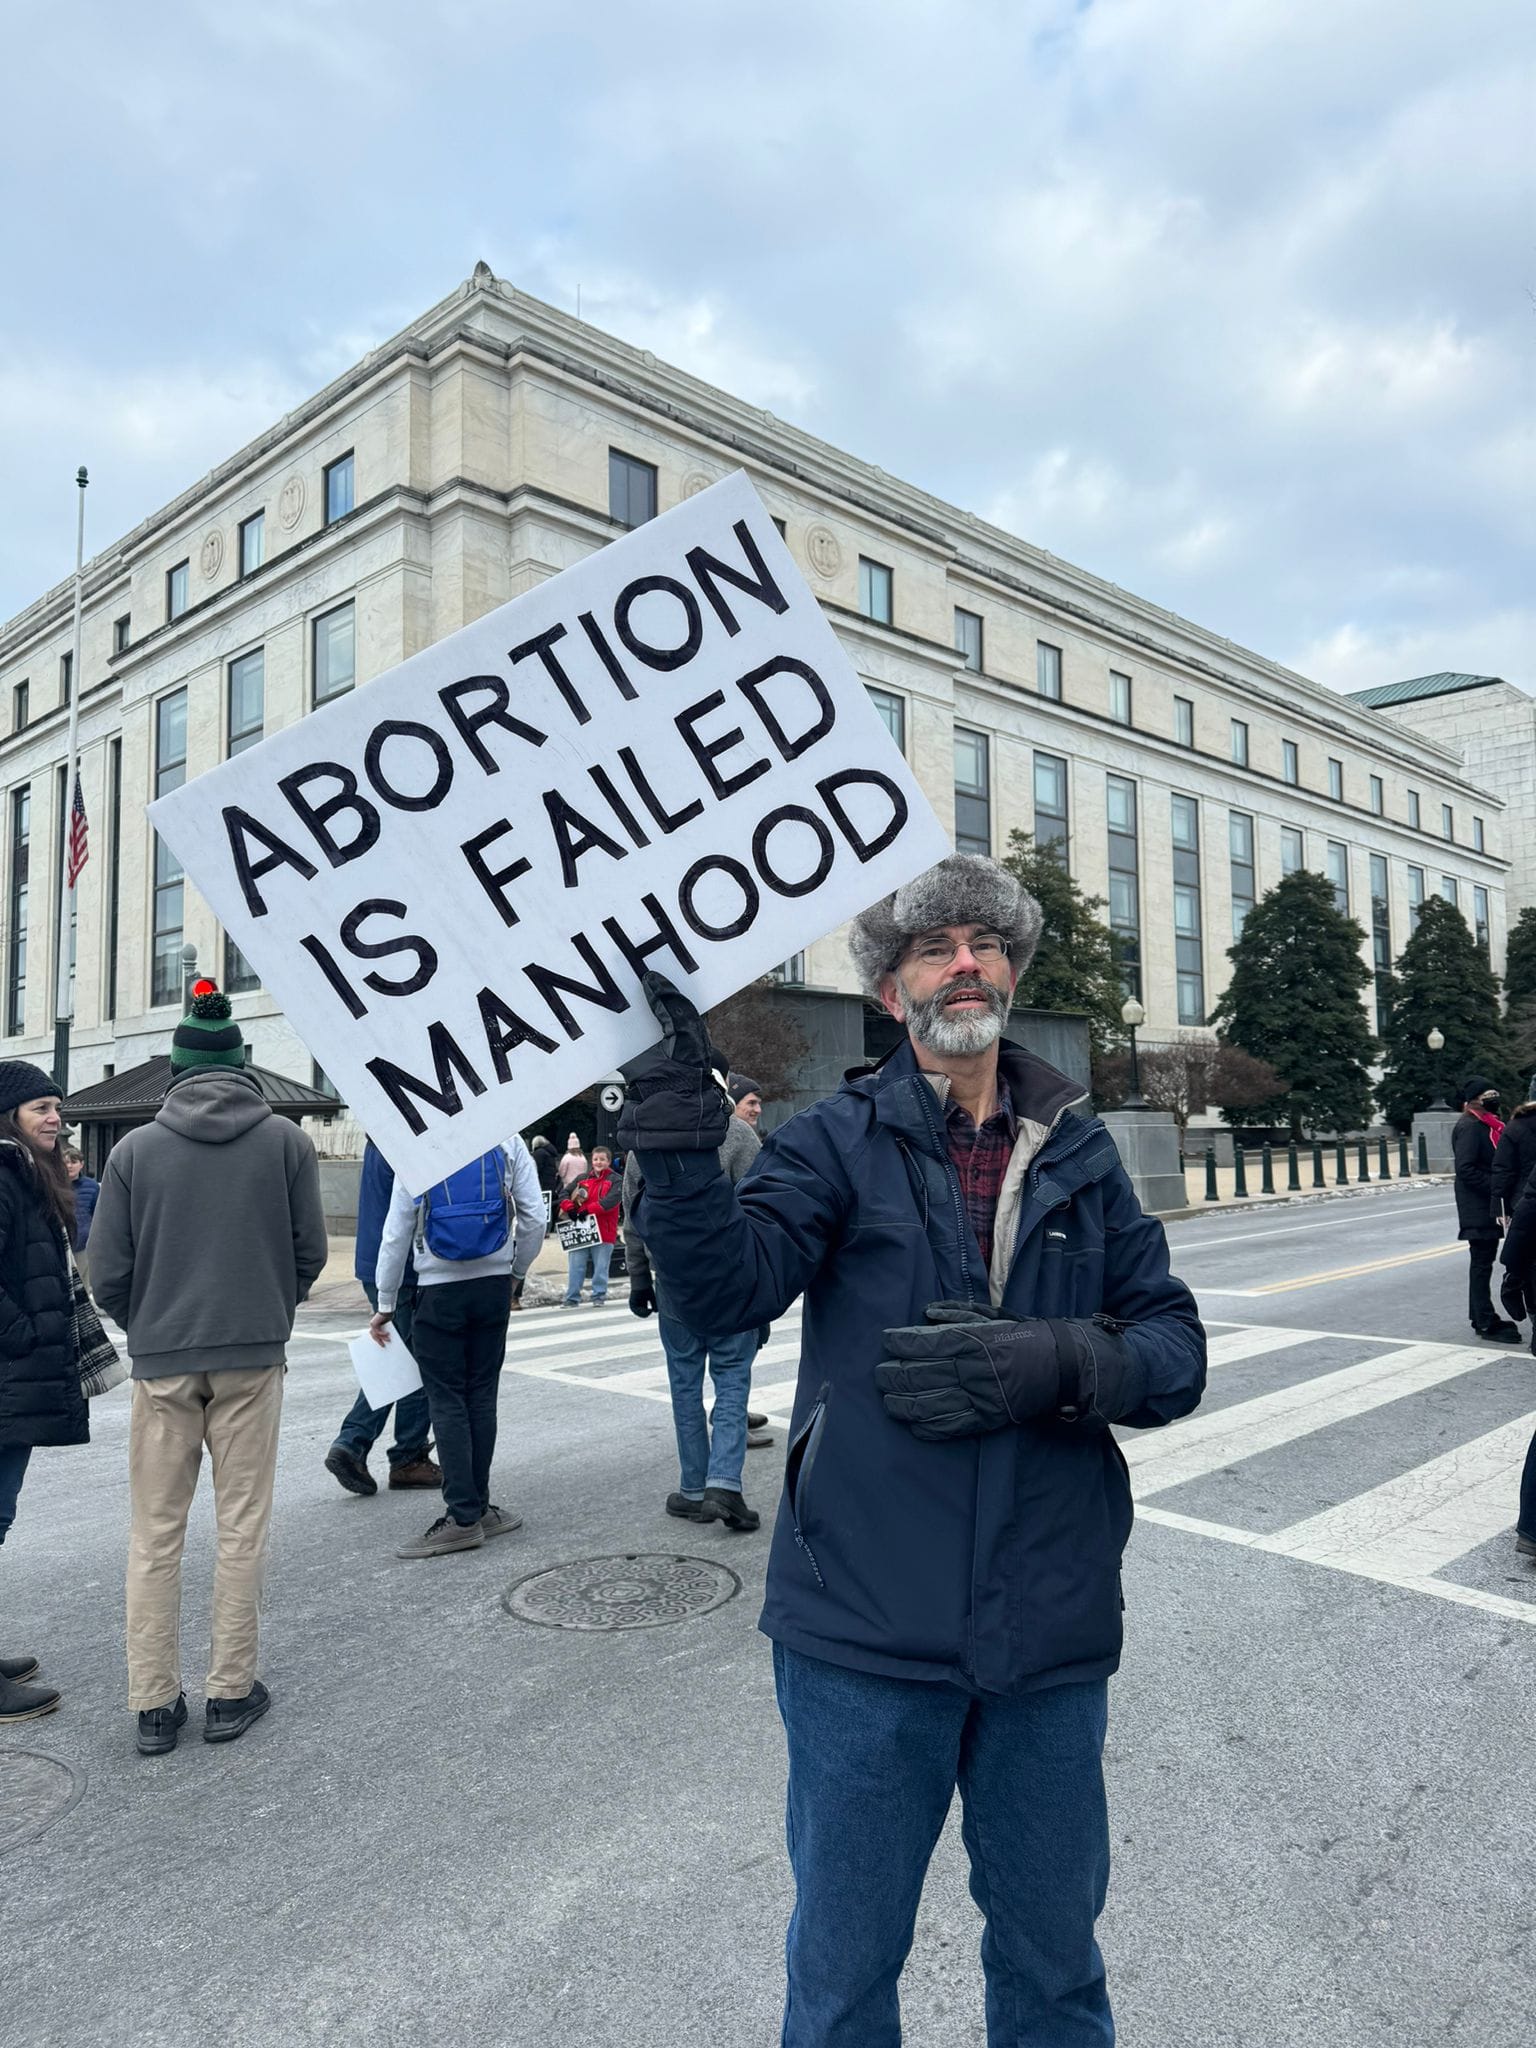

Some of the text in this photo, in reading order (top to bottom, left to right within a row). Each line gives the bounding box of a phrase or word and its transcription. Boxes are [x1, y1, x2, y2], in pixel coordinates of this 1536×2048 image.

[221, 519, 790, 918] ABORTION
[299, 655, 836, 1021] IS FAILED
[364, 768, 909, 1137] MANHOOD
[564, 1238, 578, 1247] THE
